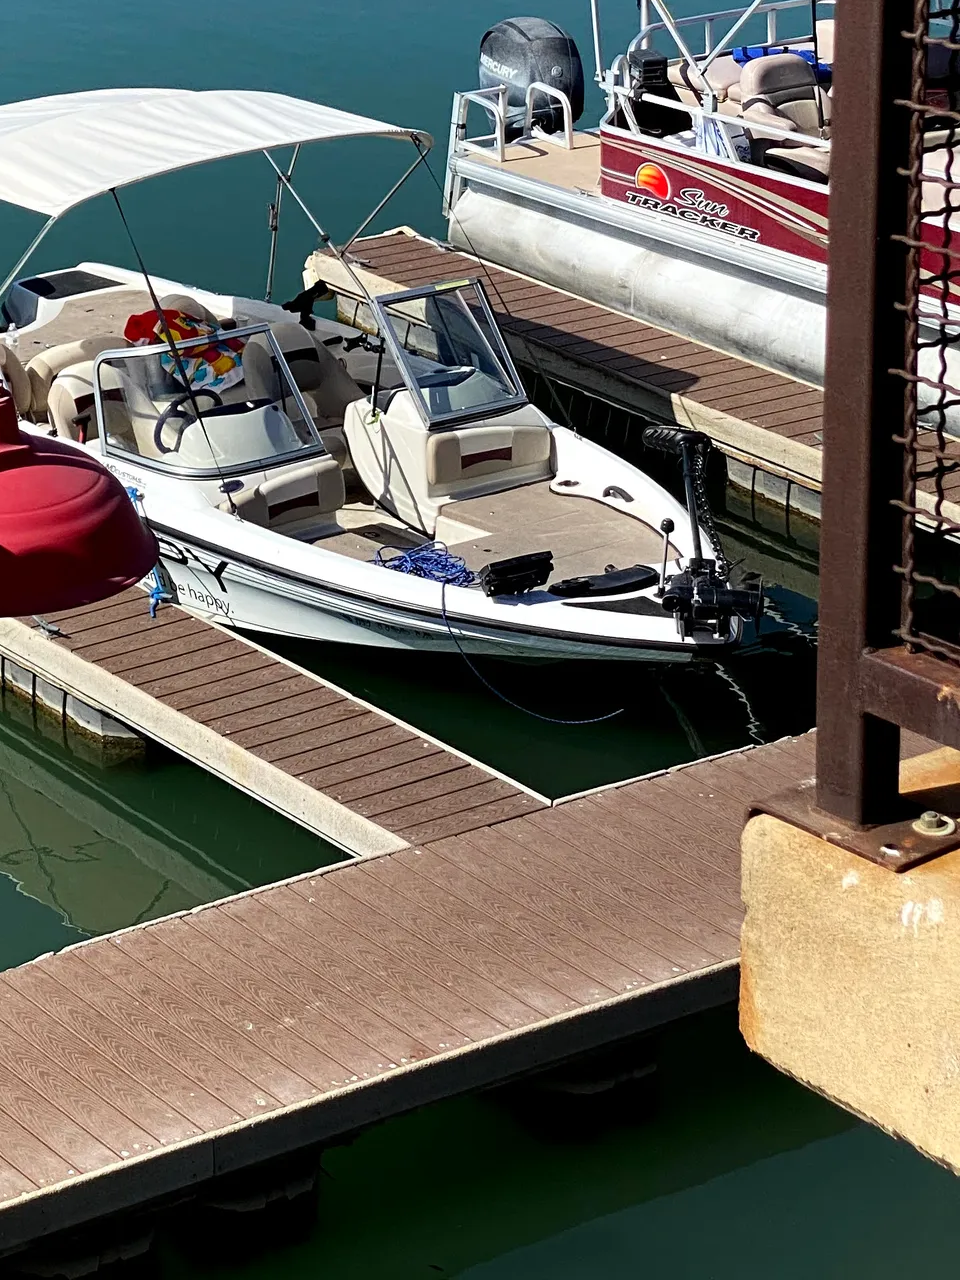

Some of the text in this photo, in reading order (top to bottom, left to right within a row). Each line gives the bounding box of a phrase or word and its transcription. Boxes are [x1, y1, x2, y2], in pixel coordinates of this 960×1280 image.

[480, 51, 518, 79] MERCURY
[625, 191, 760, 241] TRACKER
[673, 188, 730, 217] Sun
[168, 576, 186, 596] be
[187, 583, 235, 615] happy.
